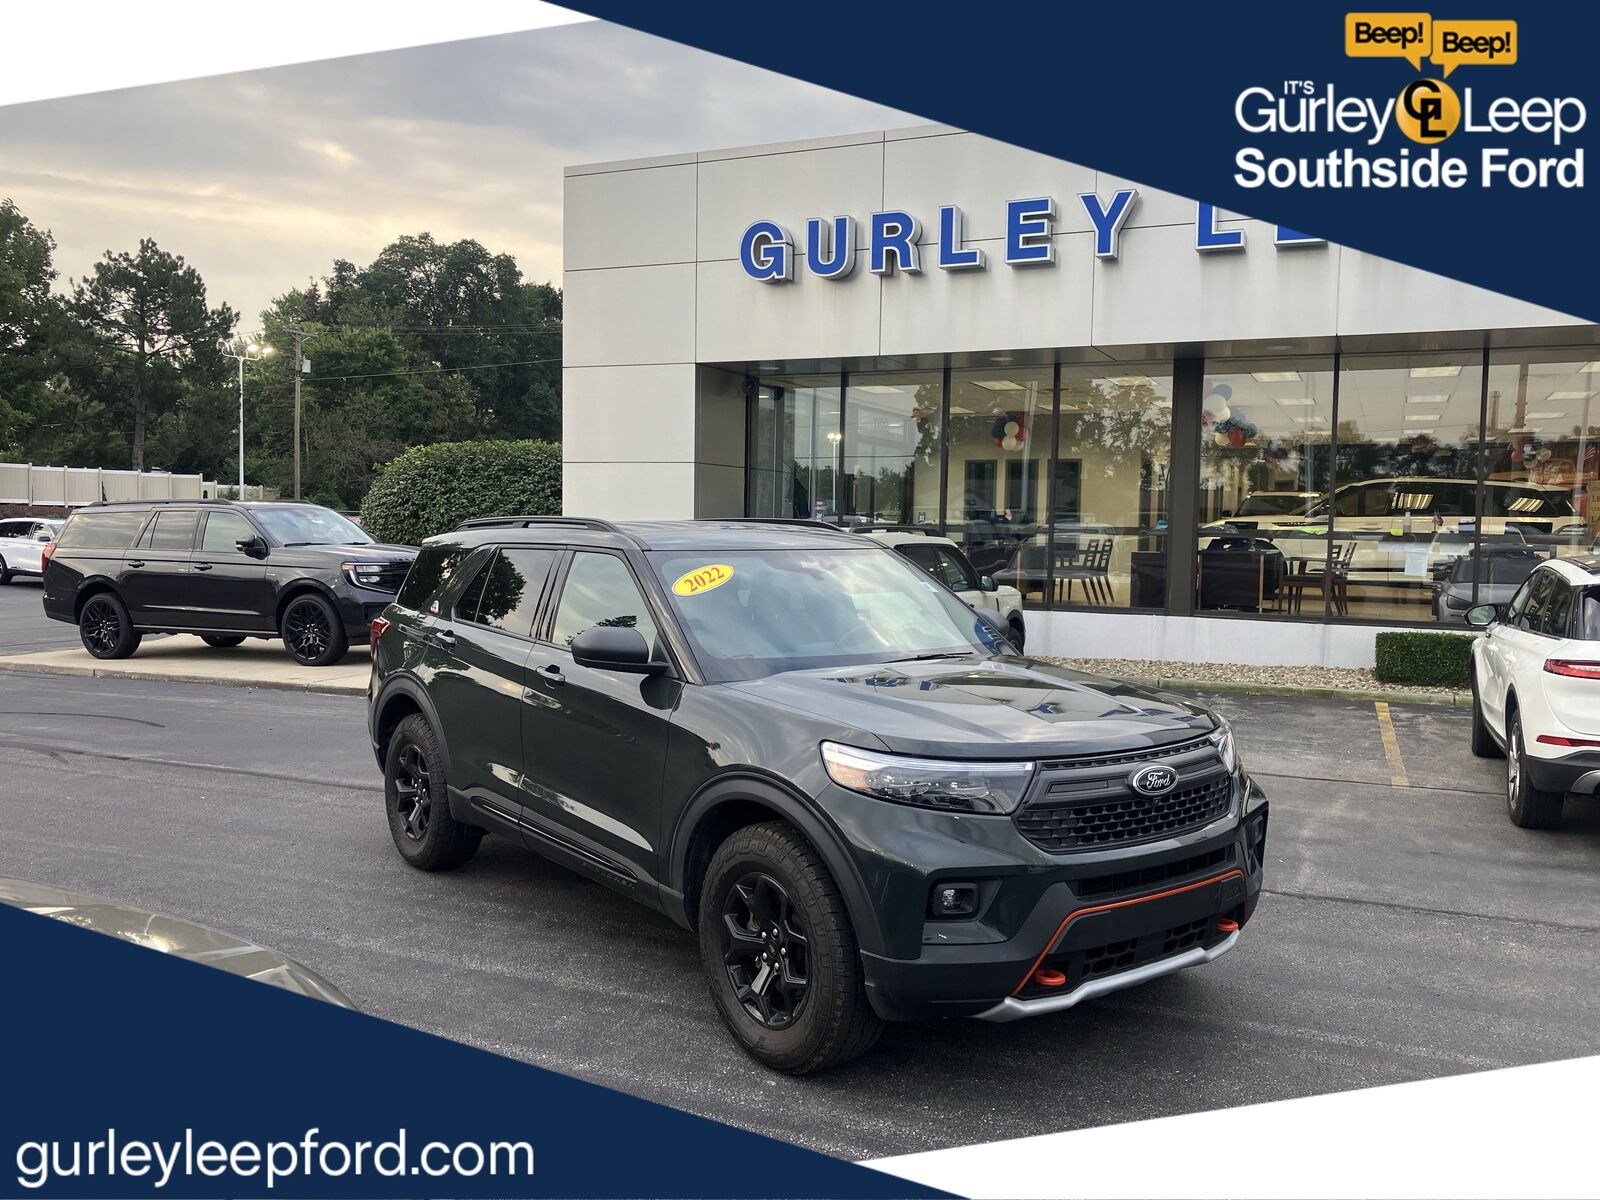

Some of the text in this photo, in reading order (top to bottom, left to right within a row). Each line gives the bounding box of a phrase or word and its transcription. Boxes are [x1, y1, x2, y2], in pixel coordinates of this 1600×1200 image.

[739, 189, 1140, 284] GURLEY
[683, 567, 725, 593] 2022
[1146, 771, 1171, 790] Ford
